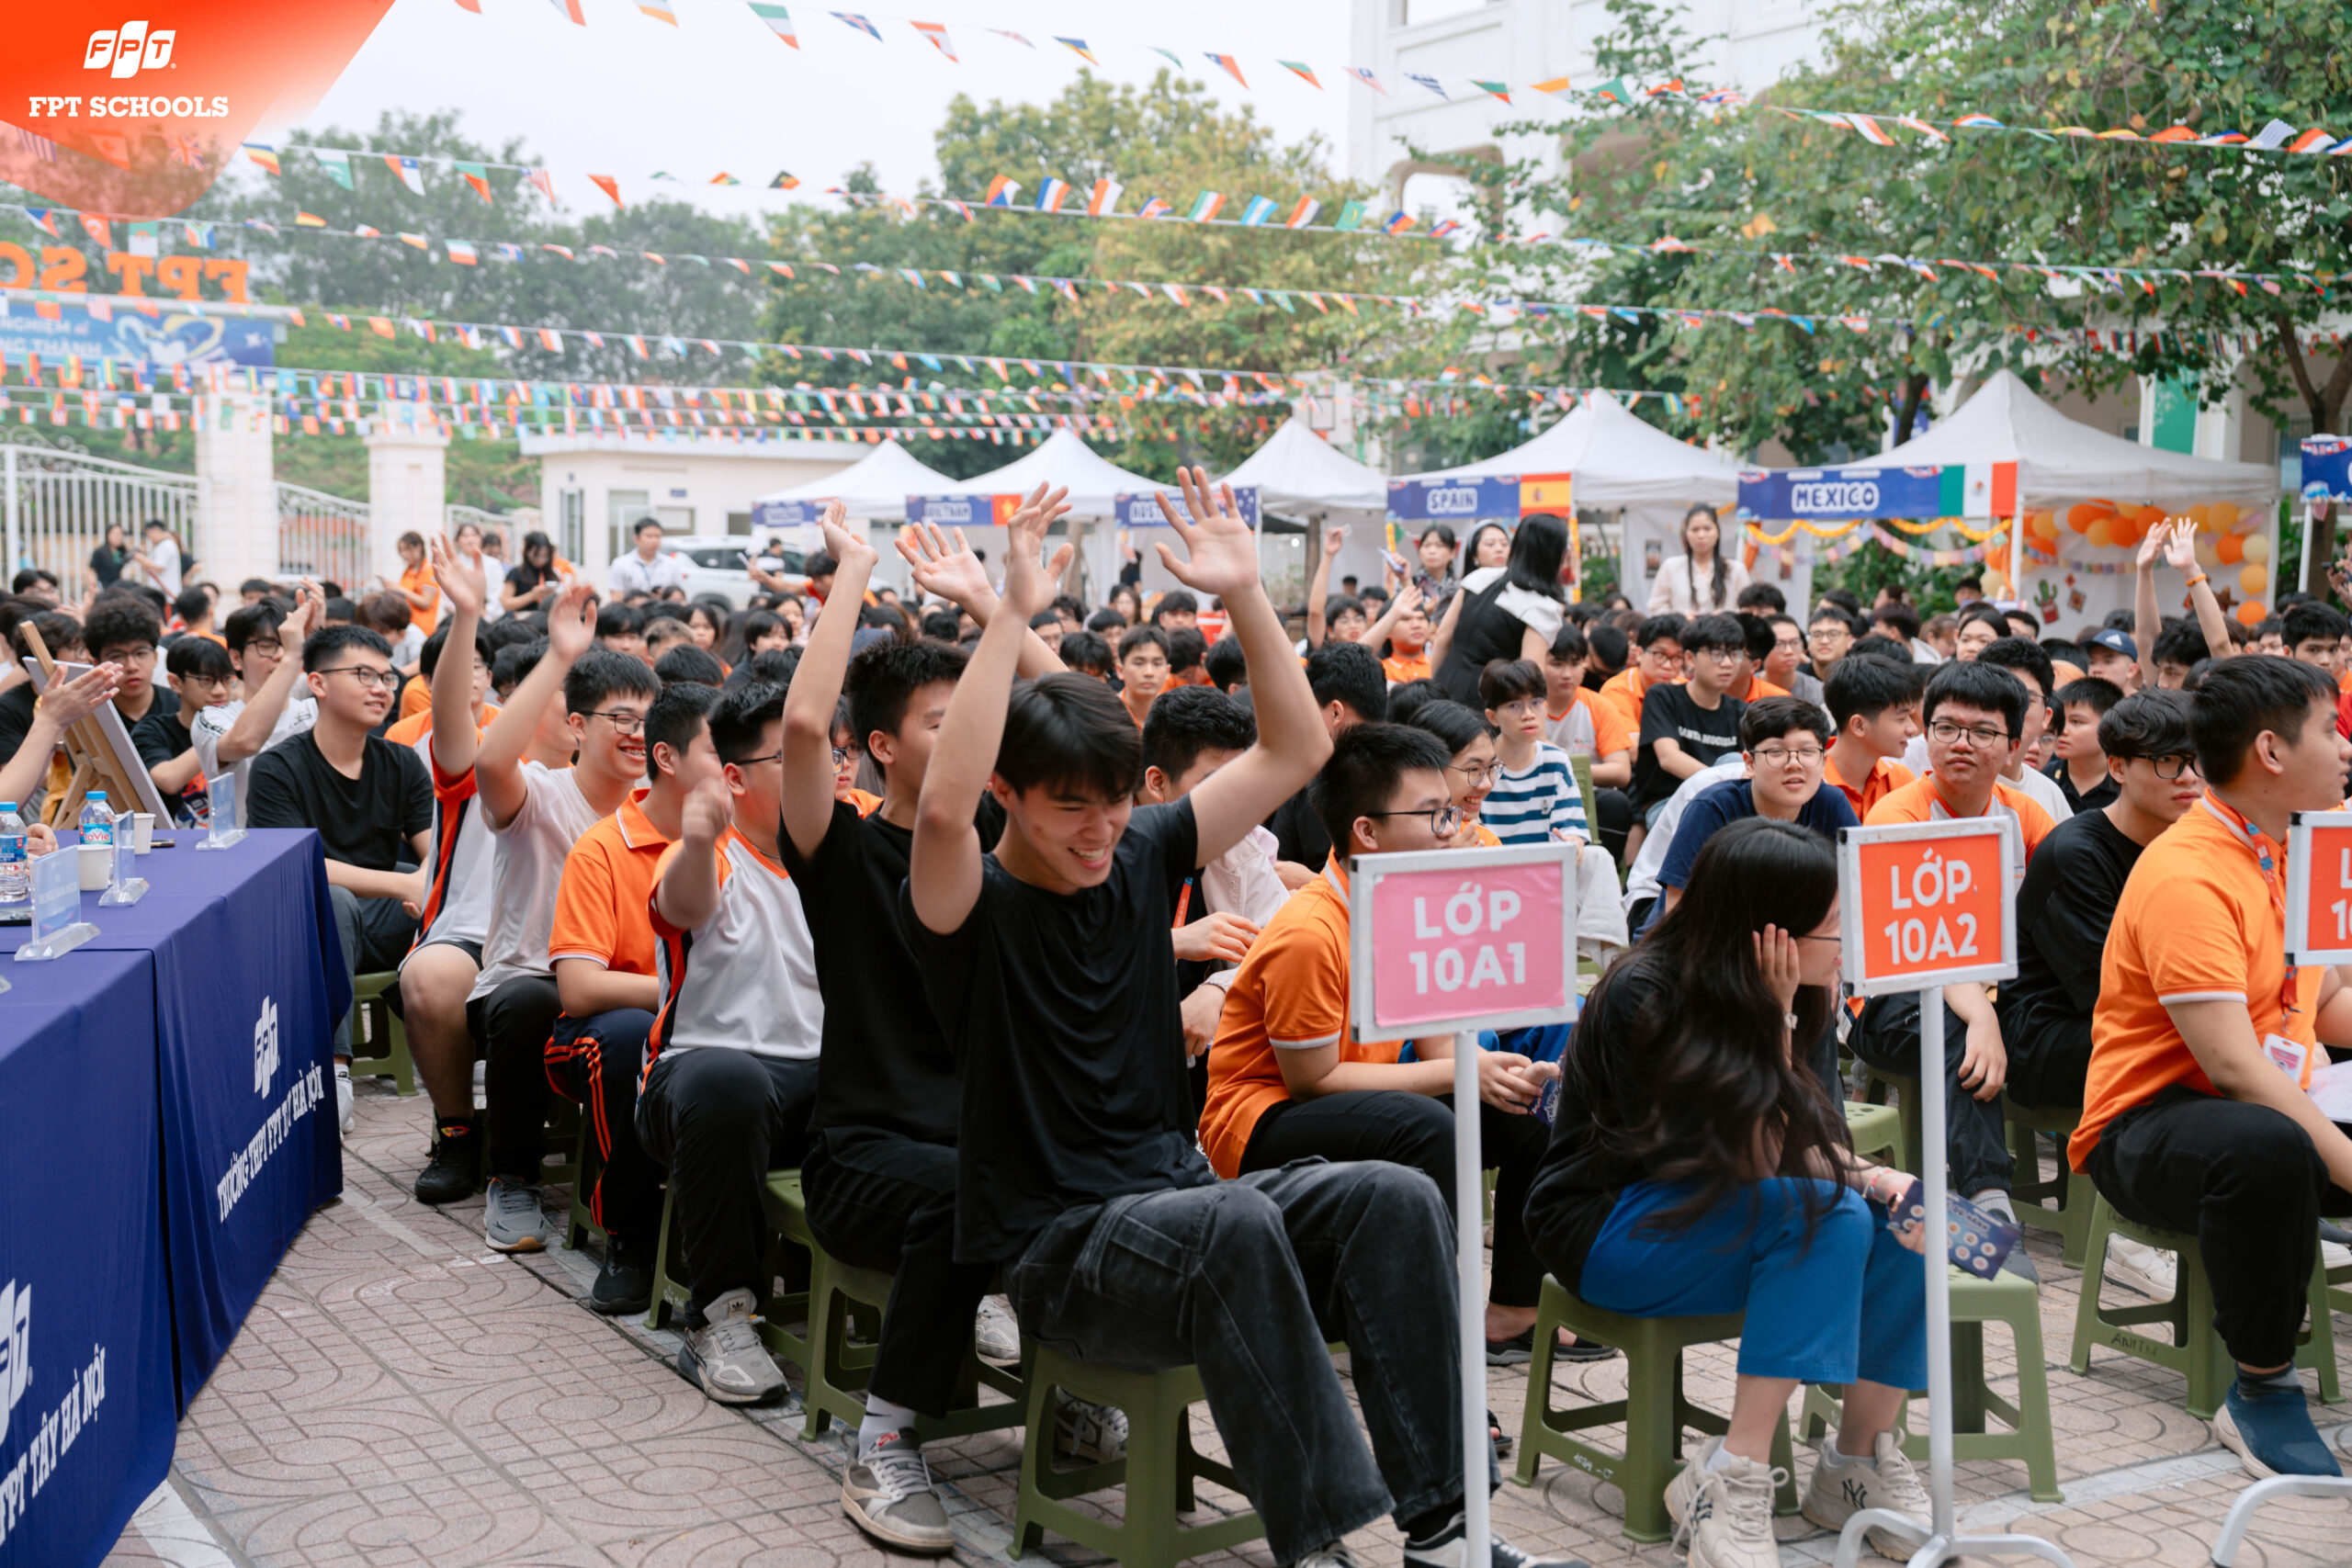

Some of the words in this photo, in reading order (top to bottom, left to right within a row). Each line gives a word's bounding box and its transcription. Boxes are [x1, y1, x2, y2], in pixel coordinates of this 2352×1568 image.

[1428, 489, 1476, 513] SPAIN
[1793, 483, 1869, 511] MEXICO
[1891, 847, 1972, 910] LỚP
[1414, 881, 1521, 940] LỚP
[1884, 912, 1978, 965] 10A2
[1409, 942, 1526, 995] 10A1
[217, 1150, 249, 1224] TRƯỜNG
[248, 1122, 268, 1179] THPT
[266, 1106, 282, 1156] FPT
[291, 1068, 309, 1122] HÀ
[30, 1410, 59, 1498] TÂY
[61, 1368, 81, 1457] HÀ
[83, 1342, 106, 1424] NỘI
